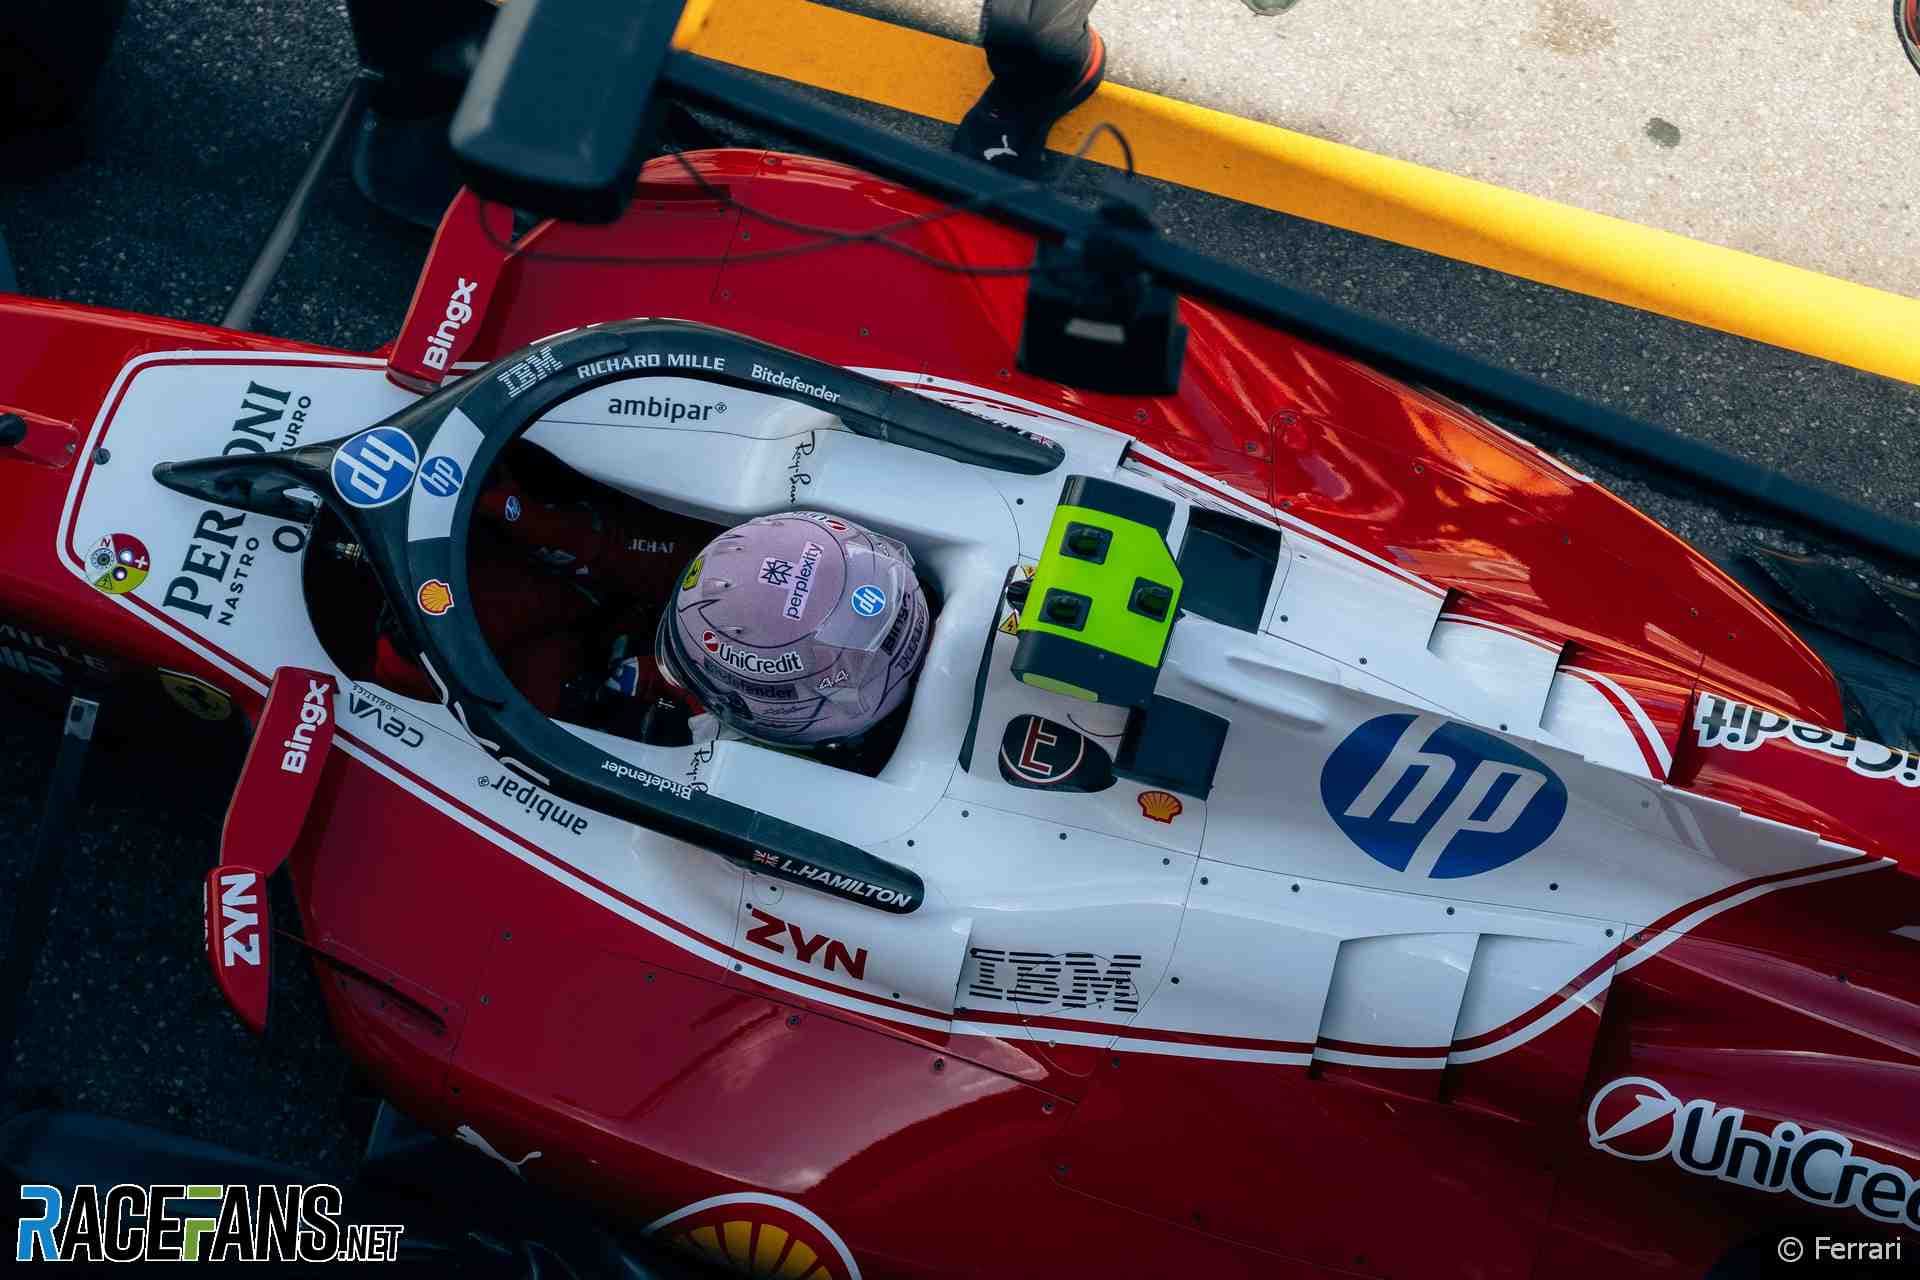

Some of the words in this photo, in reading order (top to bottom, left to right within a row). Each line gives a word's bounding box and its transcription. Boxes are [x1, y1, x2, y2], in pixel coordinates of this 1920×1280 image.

[497, 345, 564, 399] IBM
[577, 355, 661, 379] RICHARD
[668, 352, 727, 372] MILLE
[750, 363, 841, 404] Bitdefender
[419, 455, 463, 497] hp
[218, 537, 260, 626] NASTRO
[784, 543, 823, 620] perplexity
[851, 584, 886, 617] hp
[719, 642, 803, 675] UniCredit
[601, 758, 692, 800] Bitdefender
[1344, 714, 1549, 879] hp
[780, 859, 913, 909] L.HAMILTON
[219, 872, 262, 967] ZYN
[745, 907, 868, 981] ZYN
[969, 948, 1143, 1013] IBM
